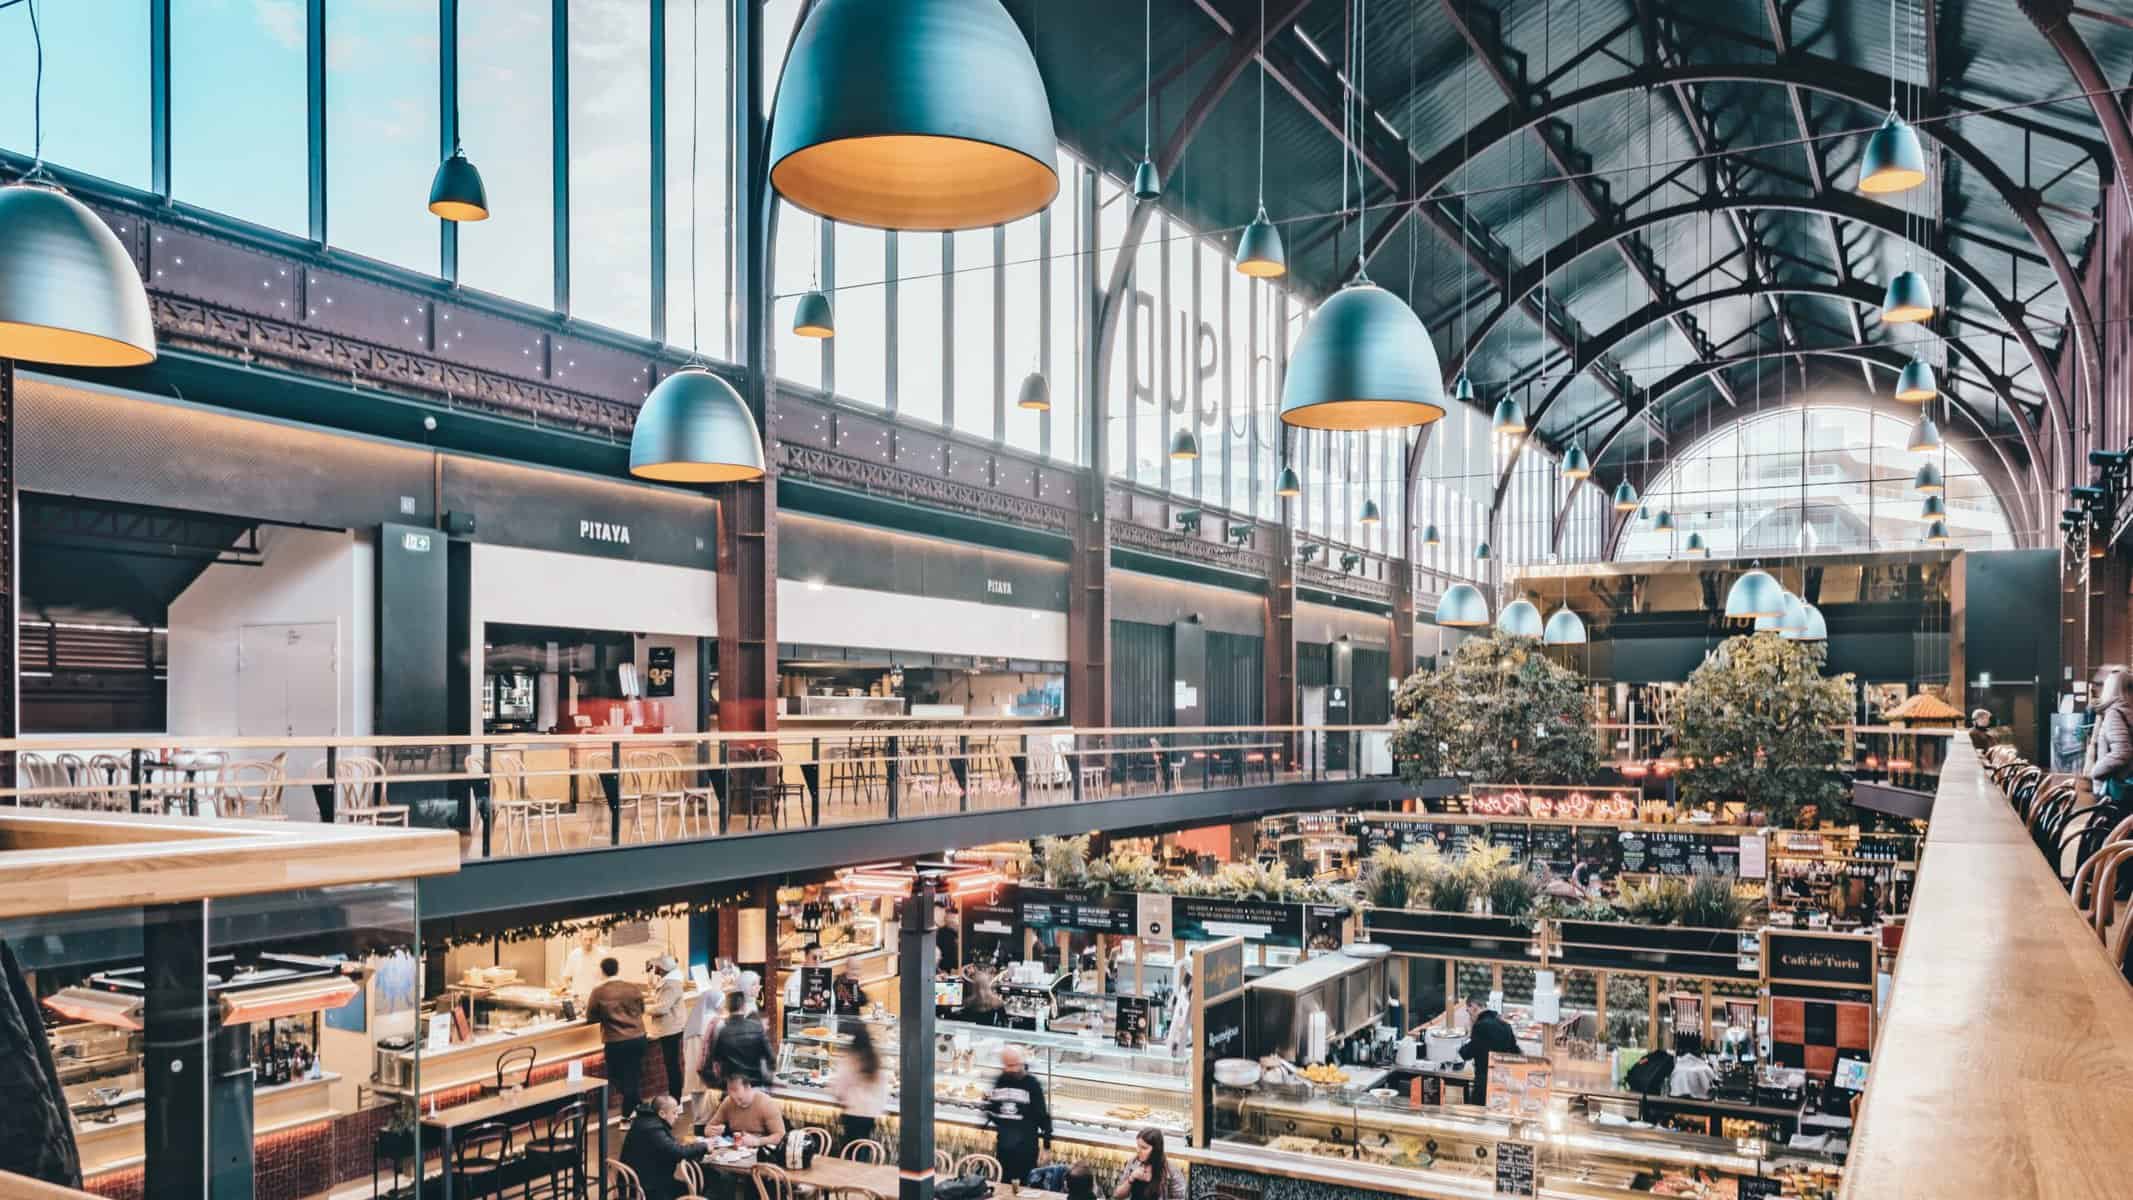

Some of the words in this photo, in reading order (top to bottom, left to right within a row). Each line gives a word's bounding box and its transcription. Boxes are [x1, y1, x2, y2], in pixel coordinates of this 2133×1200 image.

[580, 519, 631, 544] PITAYA
[987, 579, 1013, 594] PITAYA
[1414, 822, 1432, 832] JUICE
[1652, 833, 1666, 841] LES
[1782, 954, 1806, 966] Café
[1809, 955, 1822, 967] de
[1823, 955, 1860, 969] Turin
